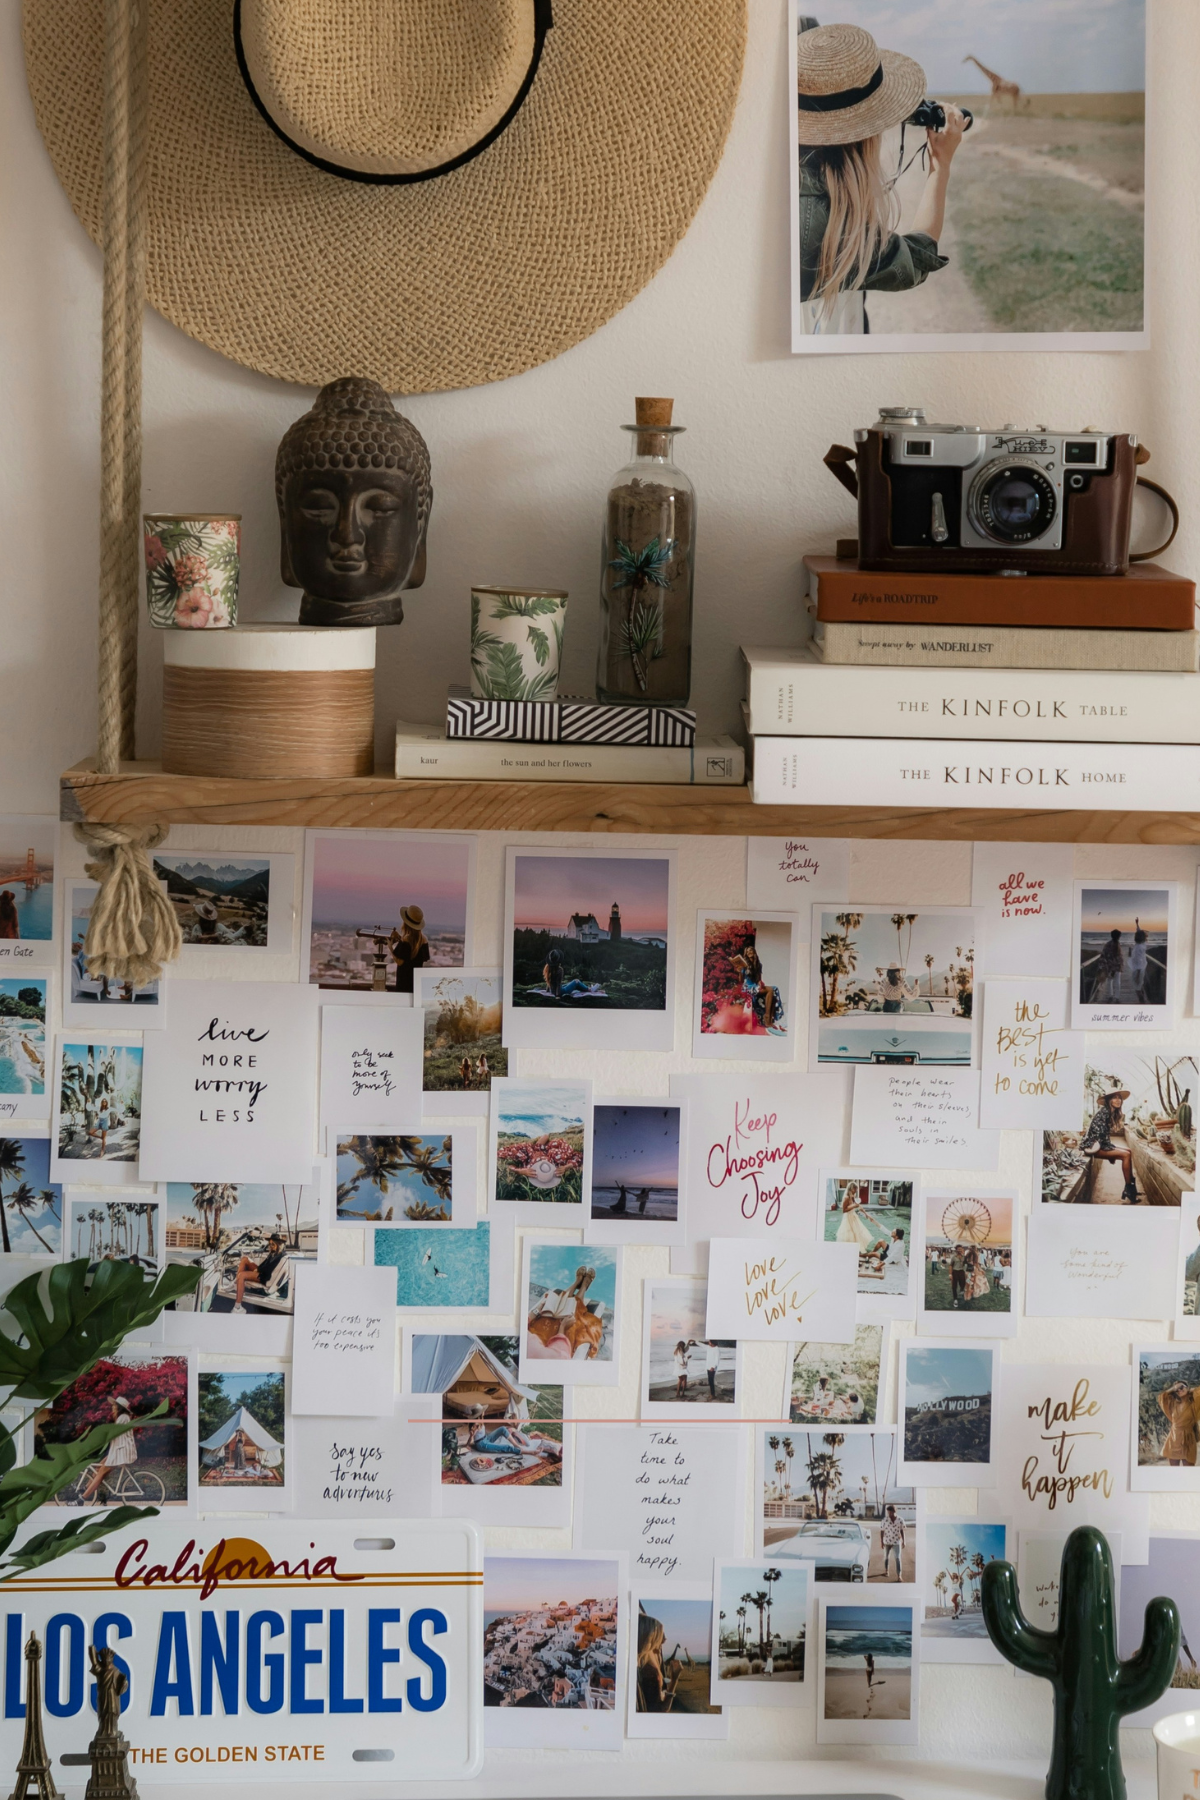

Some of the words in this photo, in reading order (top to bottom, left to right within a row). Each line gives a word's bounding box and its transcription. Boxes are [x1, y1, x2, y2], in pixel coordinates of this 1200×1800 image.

[883, 593, 938, 604] ROADTRIP
[906, 641, 916, 650] by
[921, 641, 994, 653] WANDERLUST
[898, 701, 930, 712] THE
[941, 698, 1068, 719] KINFOLK
[1080, 704, 1128, 717] TABLE
[420, 756, 438, 765] kaur
[501, 758, 513, 766] the
[531, 759, 546, 767] and
[548, 760, 561, 768] her
[562, 760, 592, 768] flowers
[900, 769, 931, 780] THE
[944, 767, 1070, 786] KINFOLK
[1081, 772, 1127, 783] HOME
[998, 872, 1024, 890] all
[1026, 880, 1044, 889] we
[1002, 890, 1038, 906] have
[1002, 908, 1010, 917] is
[1015, 904, 1046, 916] now.
[13, 945, 34, 957] Gate
[1014, 1000, 1050, 1022] the
[1091, 1014, 1130, 1022] summer
[1133, 1011, 1154, 1022] vibes
[197, 1017, 270, 1042] live
[202, 1054, 257, 1067] MORE
[352, 1048, 372, 1065] only
[353, 1060, 361, 1068] to
[1013, 1051, 1027, 1067] is
[1034, 1049, 1070, 1081] yet
[352, 1070, 377, 1078] more
[996, 1073, 1011, 1094] to
[195, 1079, 268, 1107] worry
[912, 1101, 934, 1109] their
[200, 1109, 254, 1122] LESS
[734, 1098, 778, 1150] Keep
[895, 1115, 913, 1123] and
[921, 1117, 947, 1125] their
[706, 1135, 803, 1188] Choosing
[741, 1171, 786, 1226] Joy
[314, 1340, 329, 1349] too
[1028, 1379, 1101, 1430] make
[649, 1432, 678, 1445] Take
[360, 1447, 385, 1469] yes
[641, 1451, 666, 1464] time
[674, 1452, 685, 1465] to
[1041, 1430, 1104, 1474] it
[330, 1463, 350, 1482] to
[350, 1471, 379, 1482] new
[635, 1472, 650, 1484] do
[658, 1473, 690, 1486] what
[1022, 1456, 1113, 1510] happen
[641, 1493, 681, 1505] makes
[642, 1516, 676, 1535] your
[647, 1534, 674, 1545] soul
[114, 1538, 365, 1600] California
[637, 1553, 682, 1576] happy.
[149, 1607, 449, 1717] ANGELES
[130, 1748, 167, 1764] THE
[174, 1746, 258, 1763] GOLDEN
[264, 1745, 325, 1761] STATE
